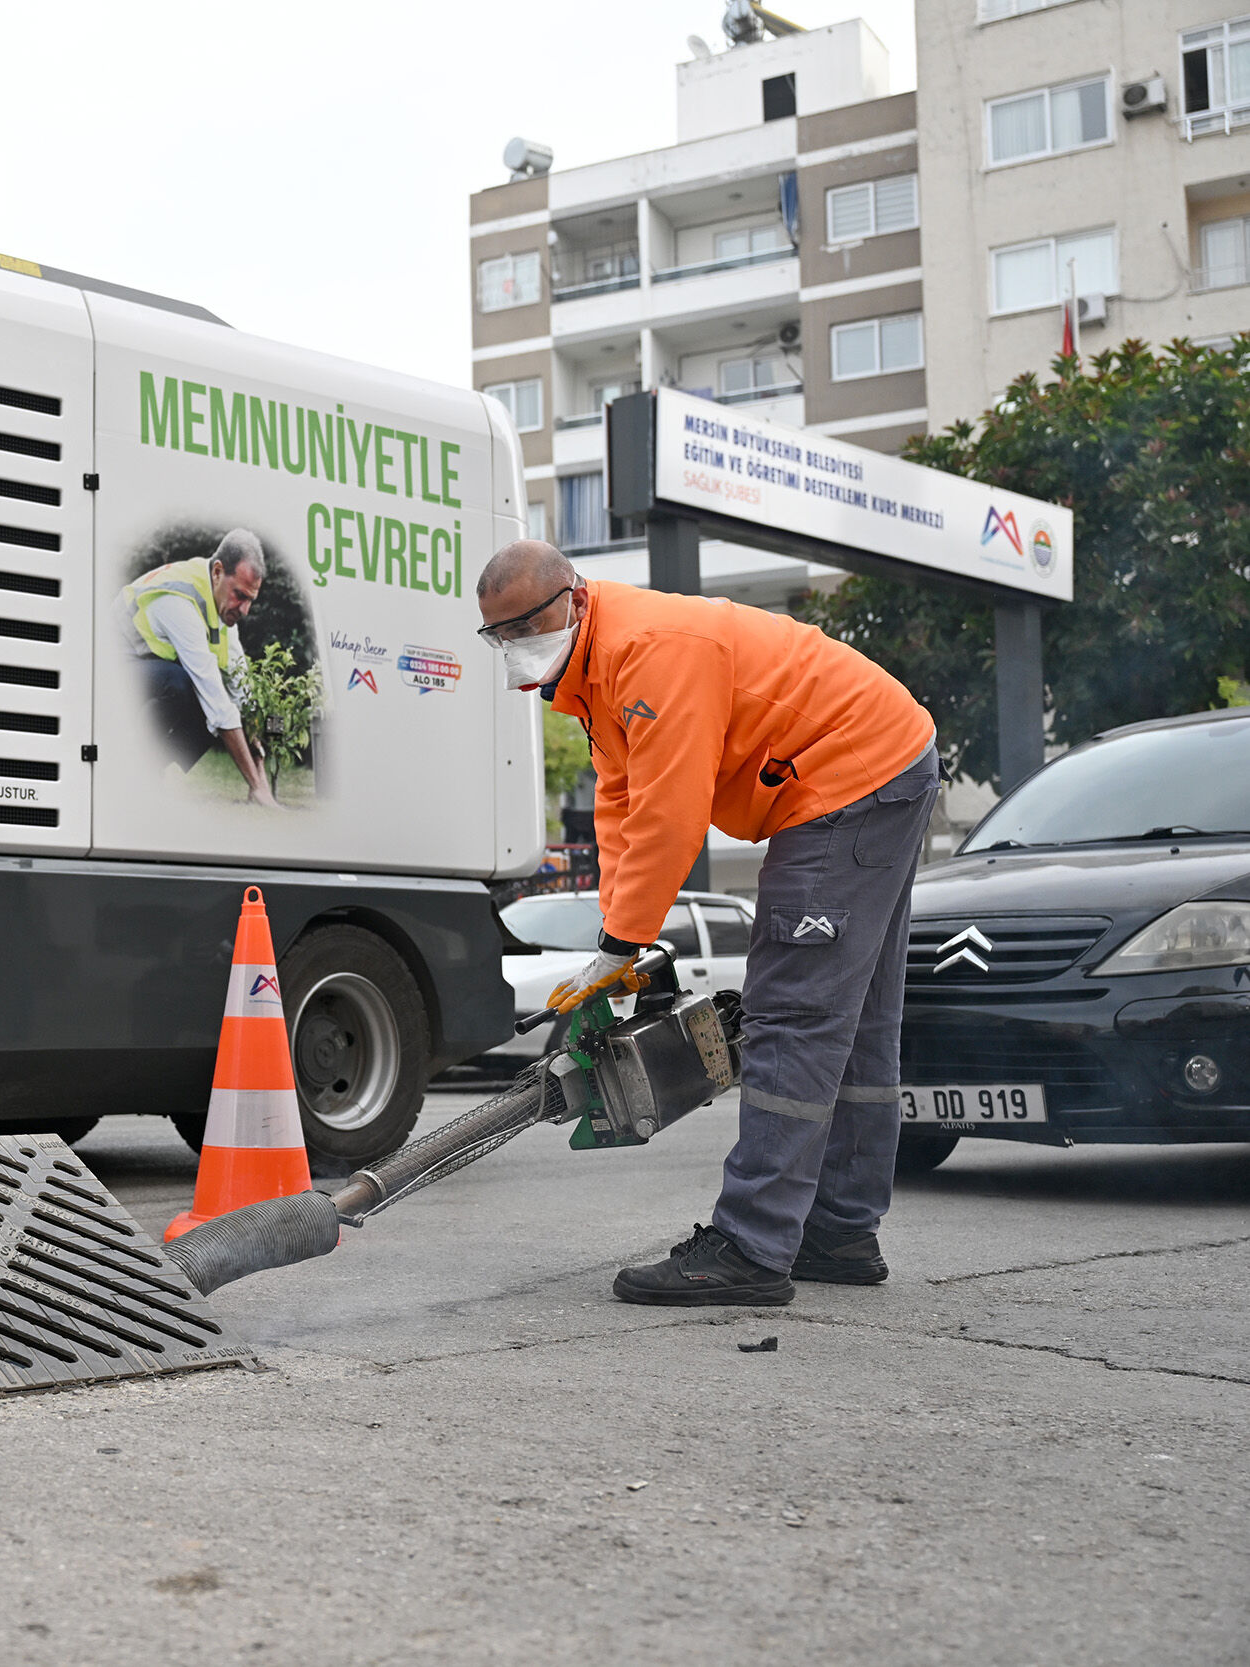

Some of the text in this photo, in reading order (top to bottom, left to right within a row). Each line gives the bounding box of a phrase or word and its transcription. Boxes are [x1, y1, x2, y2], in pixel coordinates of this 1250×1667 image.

[140, 370, 462, 509] MEMNUNİYETLE
[685, 414, 728, 442] MERSİN
[806, 450, 863, 481] BELEDİYESİ
[684, 440, 944, 530] EĞİTİM VE ÖĞRETİMİ DESTEKLEME KURS MERKEZİ
[307, 502, 462, 599] ÇEVRECİ
[414, 674, 445, 688] ALO 185
[900, 1089, 1028, 1119] 3 DD 919
